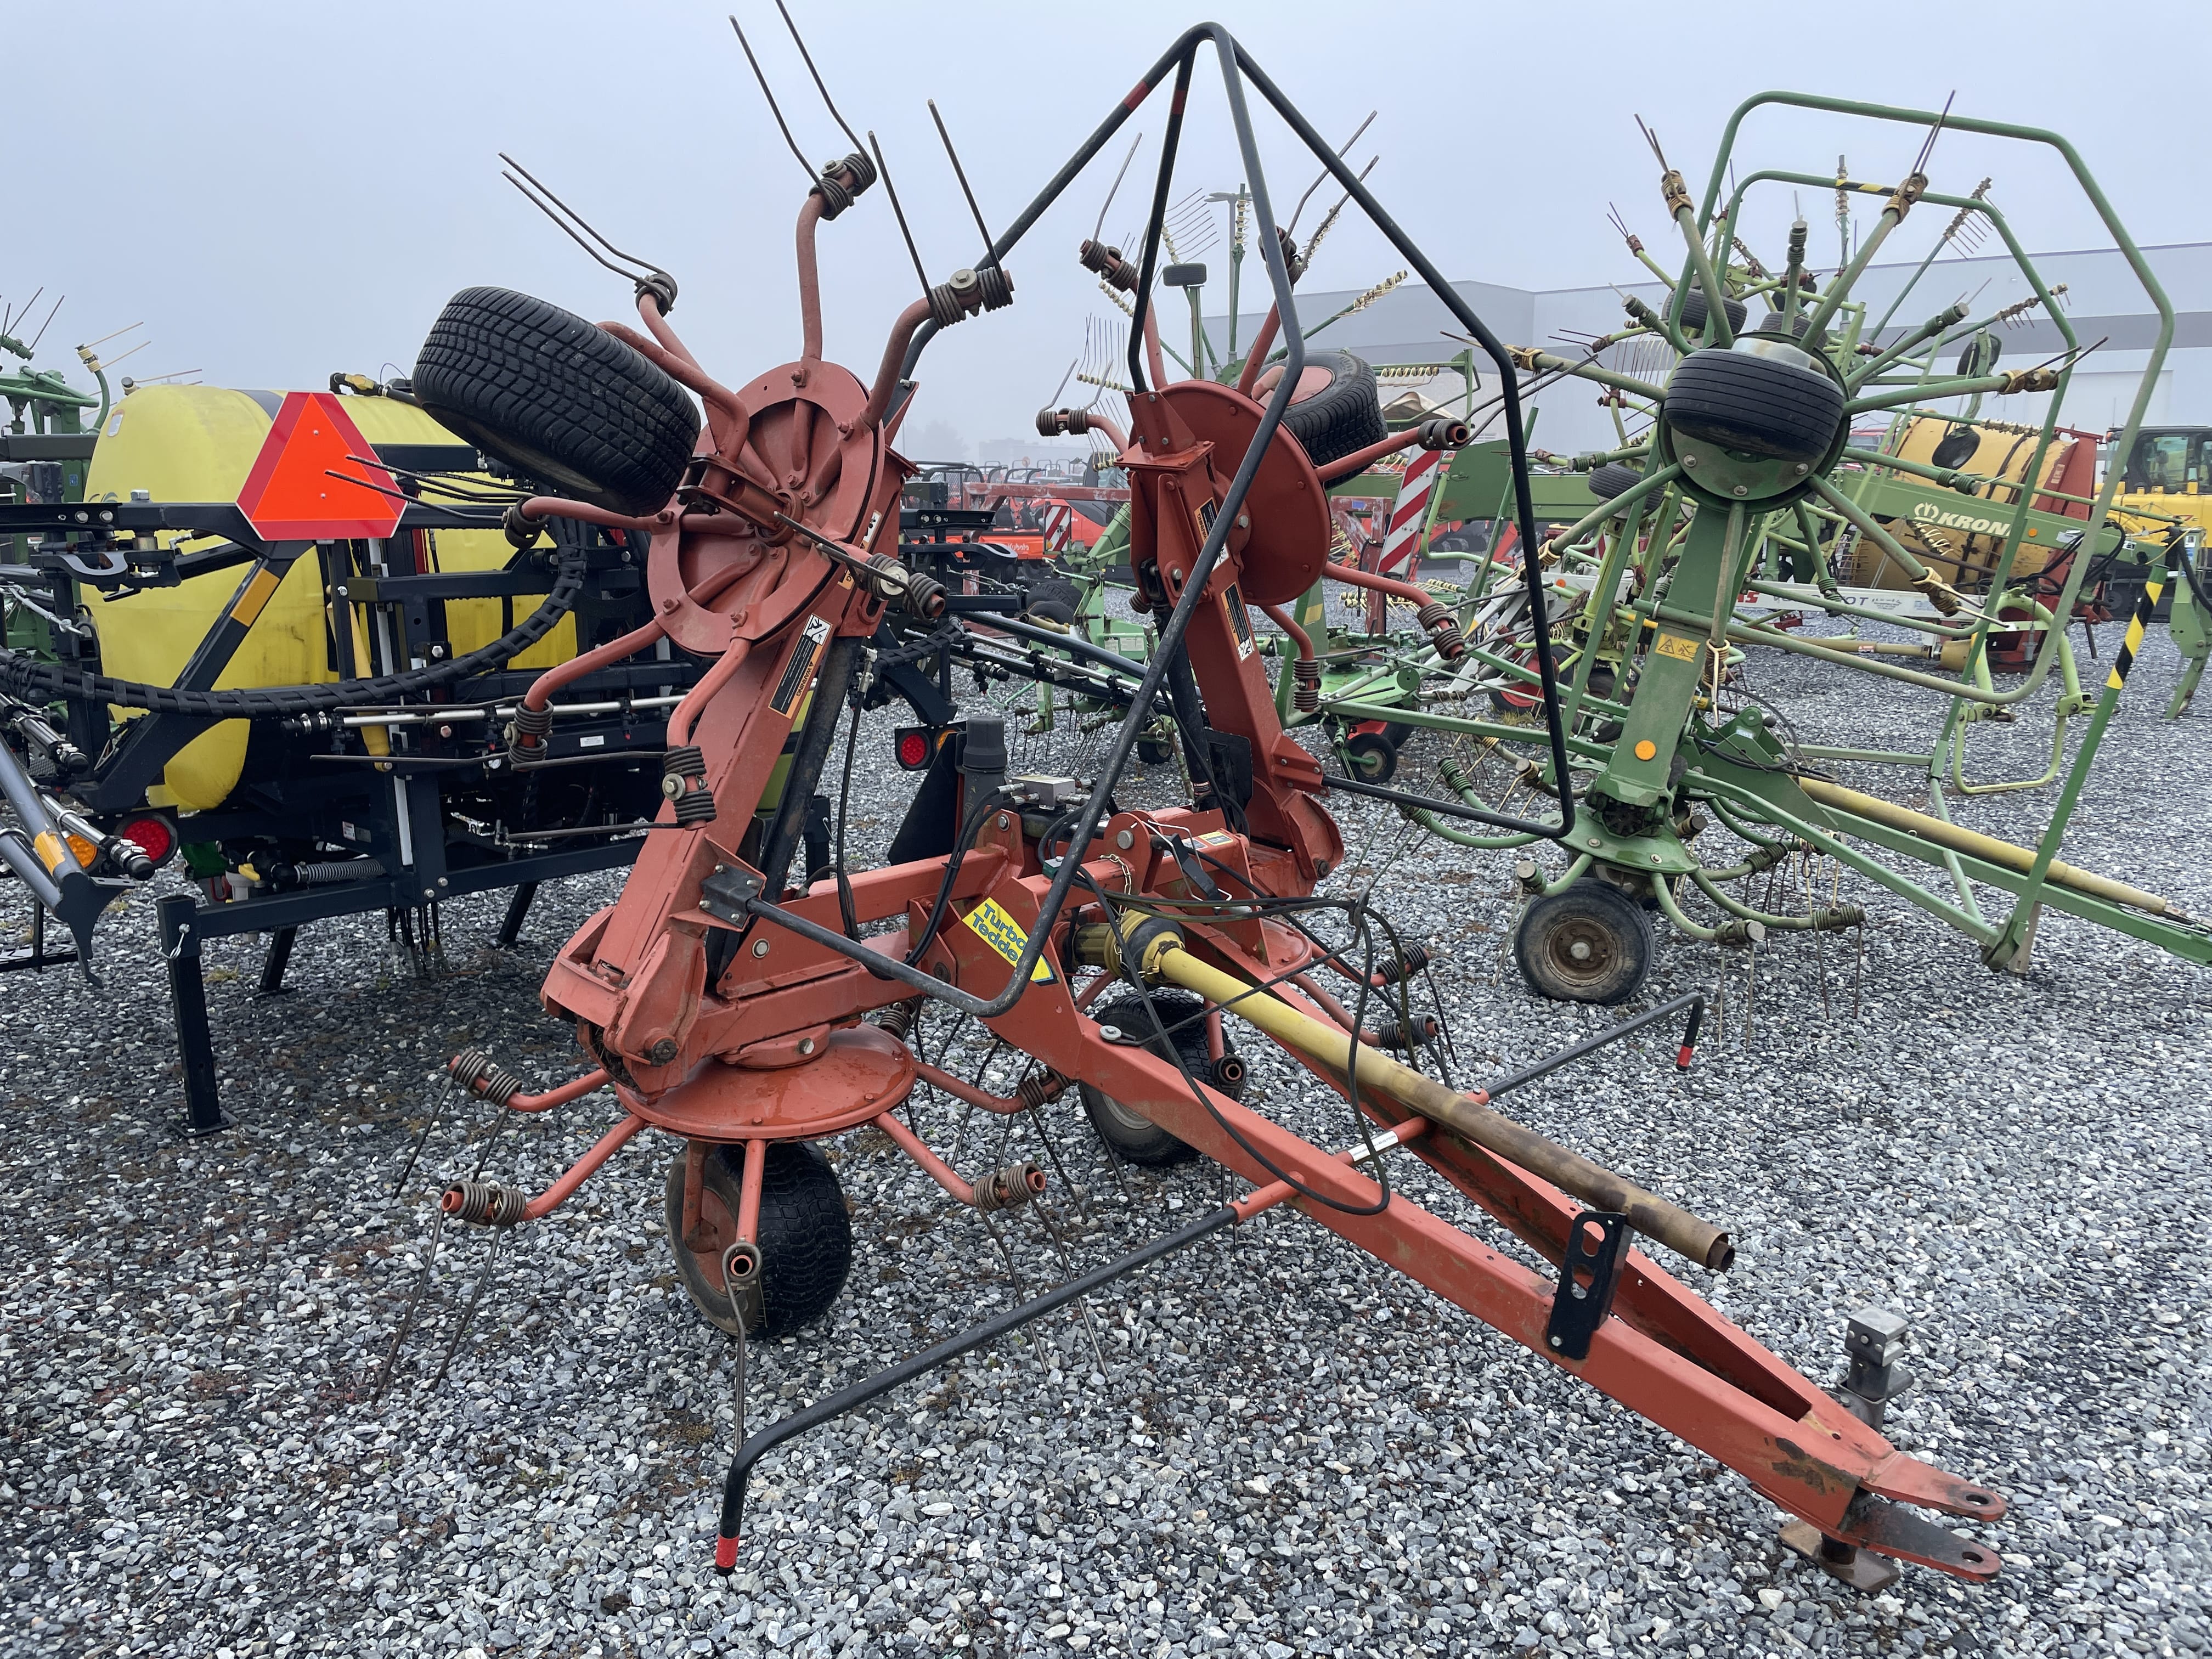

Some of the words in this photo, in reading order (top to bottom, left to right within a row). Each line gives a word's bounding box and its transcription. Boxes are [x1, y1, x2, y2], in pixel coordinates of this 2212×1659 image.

[1937, 512, 2011, 537] KRON
[796, 668, 812, 697] WARNING
[973, 912, 1018, 962] Tedde
[984, 903, 1026, 951] Turbo
